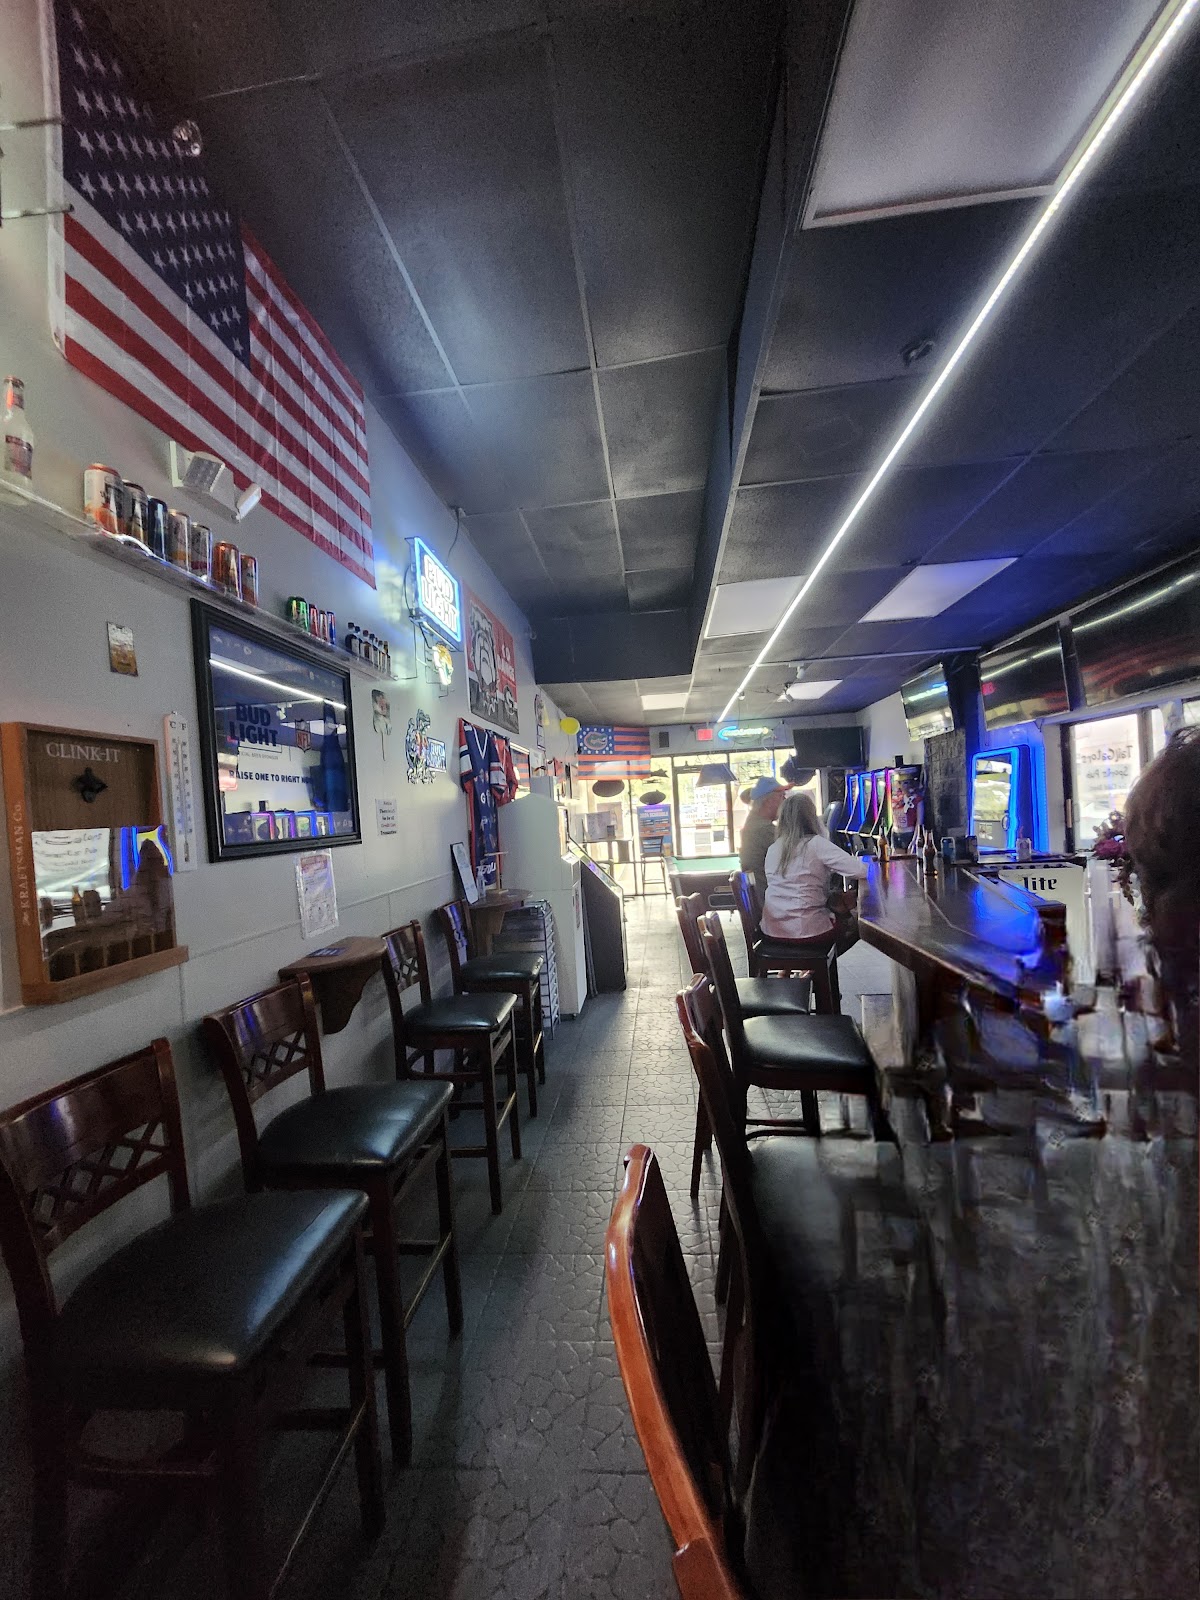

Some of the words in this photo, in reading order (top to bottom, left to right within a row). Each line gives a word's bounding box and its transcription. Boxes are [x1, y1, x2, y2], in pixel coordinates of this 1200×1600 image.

[423, 554, 454, 604] BUD
[421, 575, 459, 634] LIGHT
[236, 702, 271, 727] BUD
[229, 720, 279, 747] LIGHT
[46, 742, 120, 763] CLINK-IT
[229, 770, 254, 781] RAISE
[254, 772, 270, 781] ONE
[271, 774, 280, 782] TO
[281, 775, 301, 784] RIGHT
